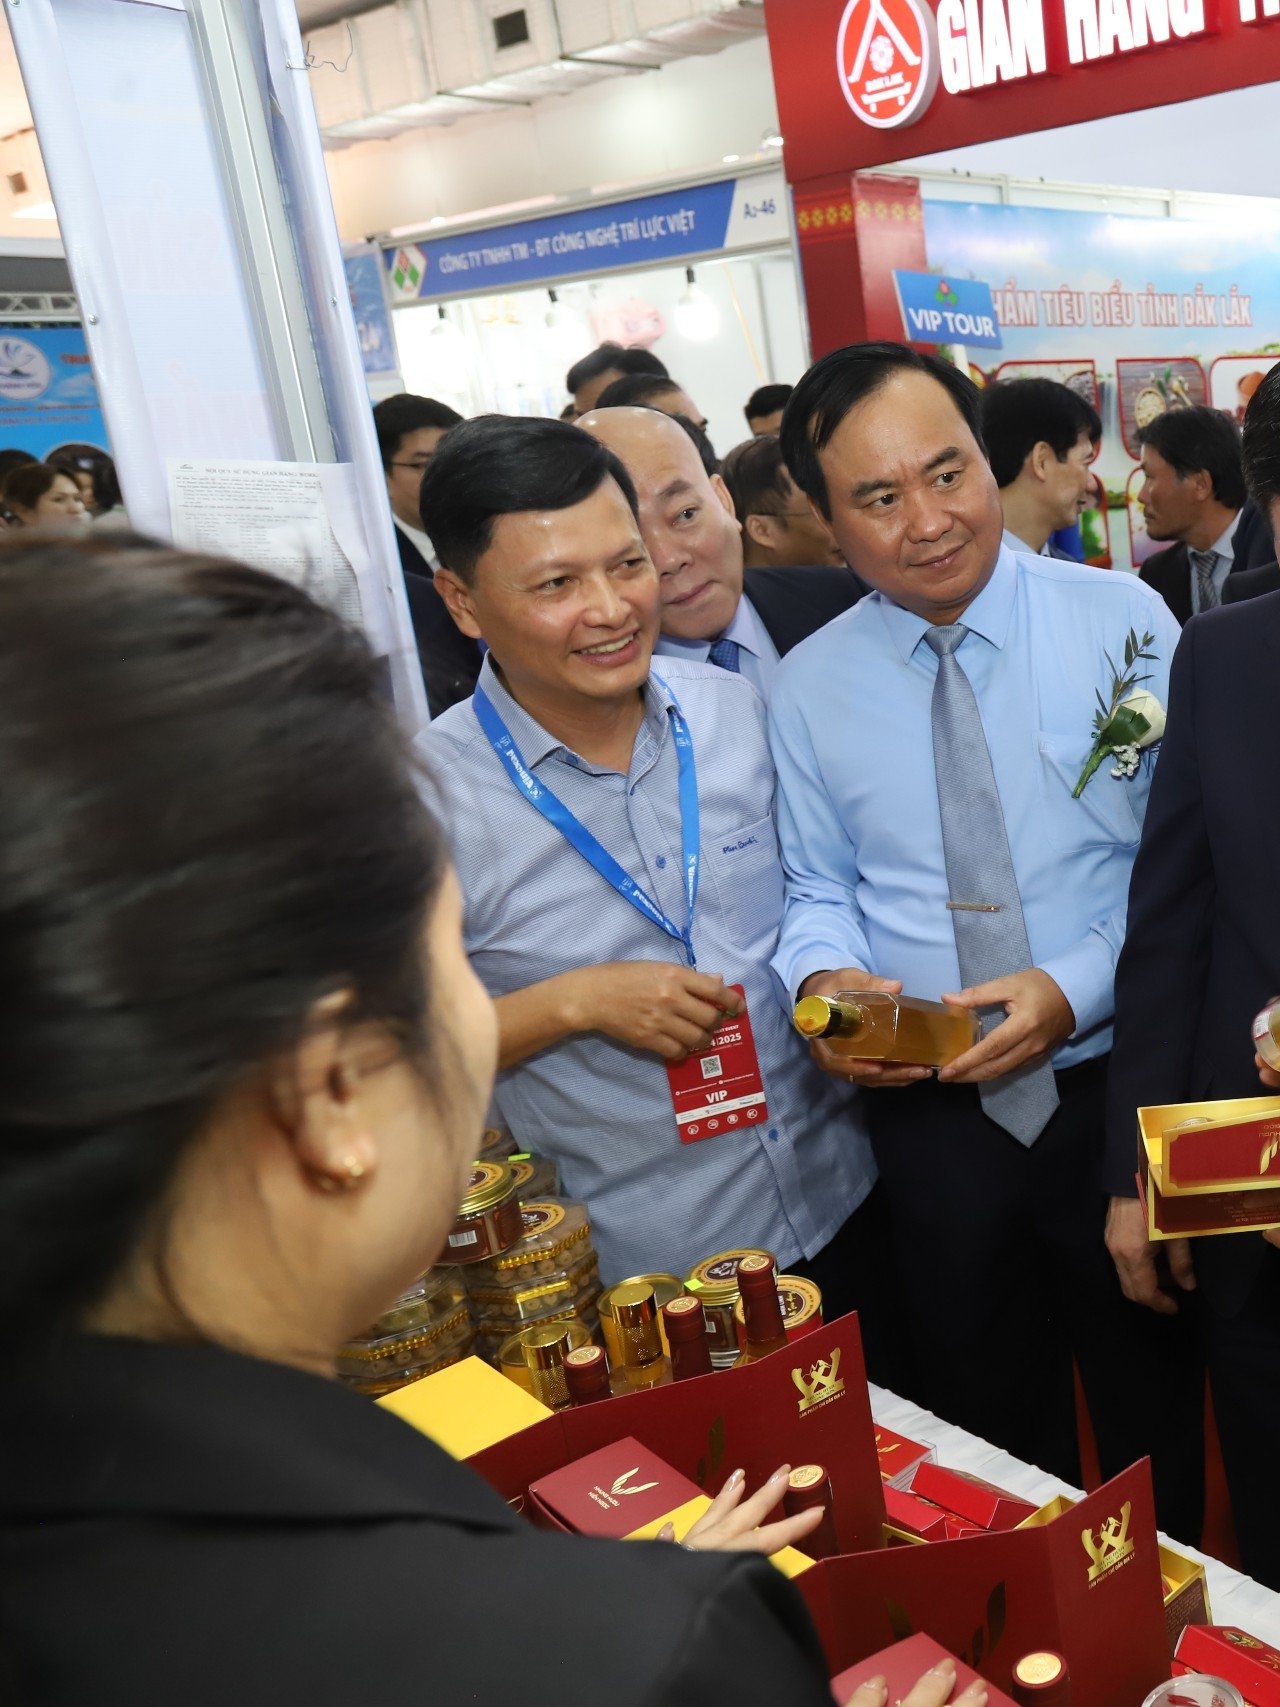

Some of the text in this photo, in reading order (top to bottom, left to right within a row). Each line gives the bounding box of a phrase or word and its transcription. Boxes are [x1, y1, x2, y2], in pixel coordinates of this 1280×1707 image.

[468, 252, 481, 271] TY
[482, 247, 512, 267] TNHH
[551, 231, 585, 254] CÔNG
[585, 221, 620, 248] NGHỆ
[620, 216, 640, 241] TRÍ
[640, 212, 666, 243] LỰC
[667, 208, 695, 237] VIỆT
[991, 277, 1253, 327] HẨM TIÊU BIỂU TỈNH ĐẮK LẮK
[908, 307, 997, 338] VIP TOUR
[705, 1090, 728, 1103] VIP
